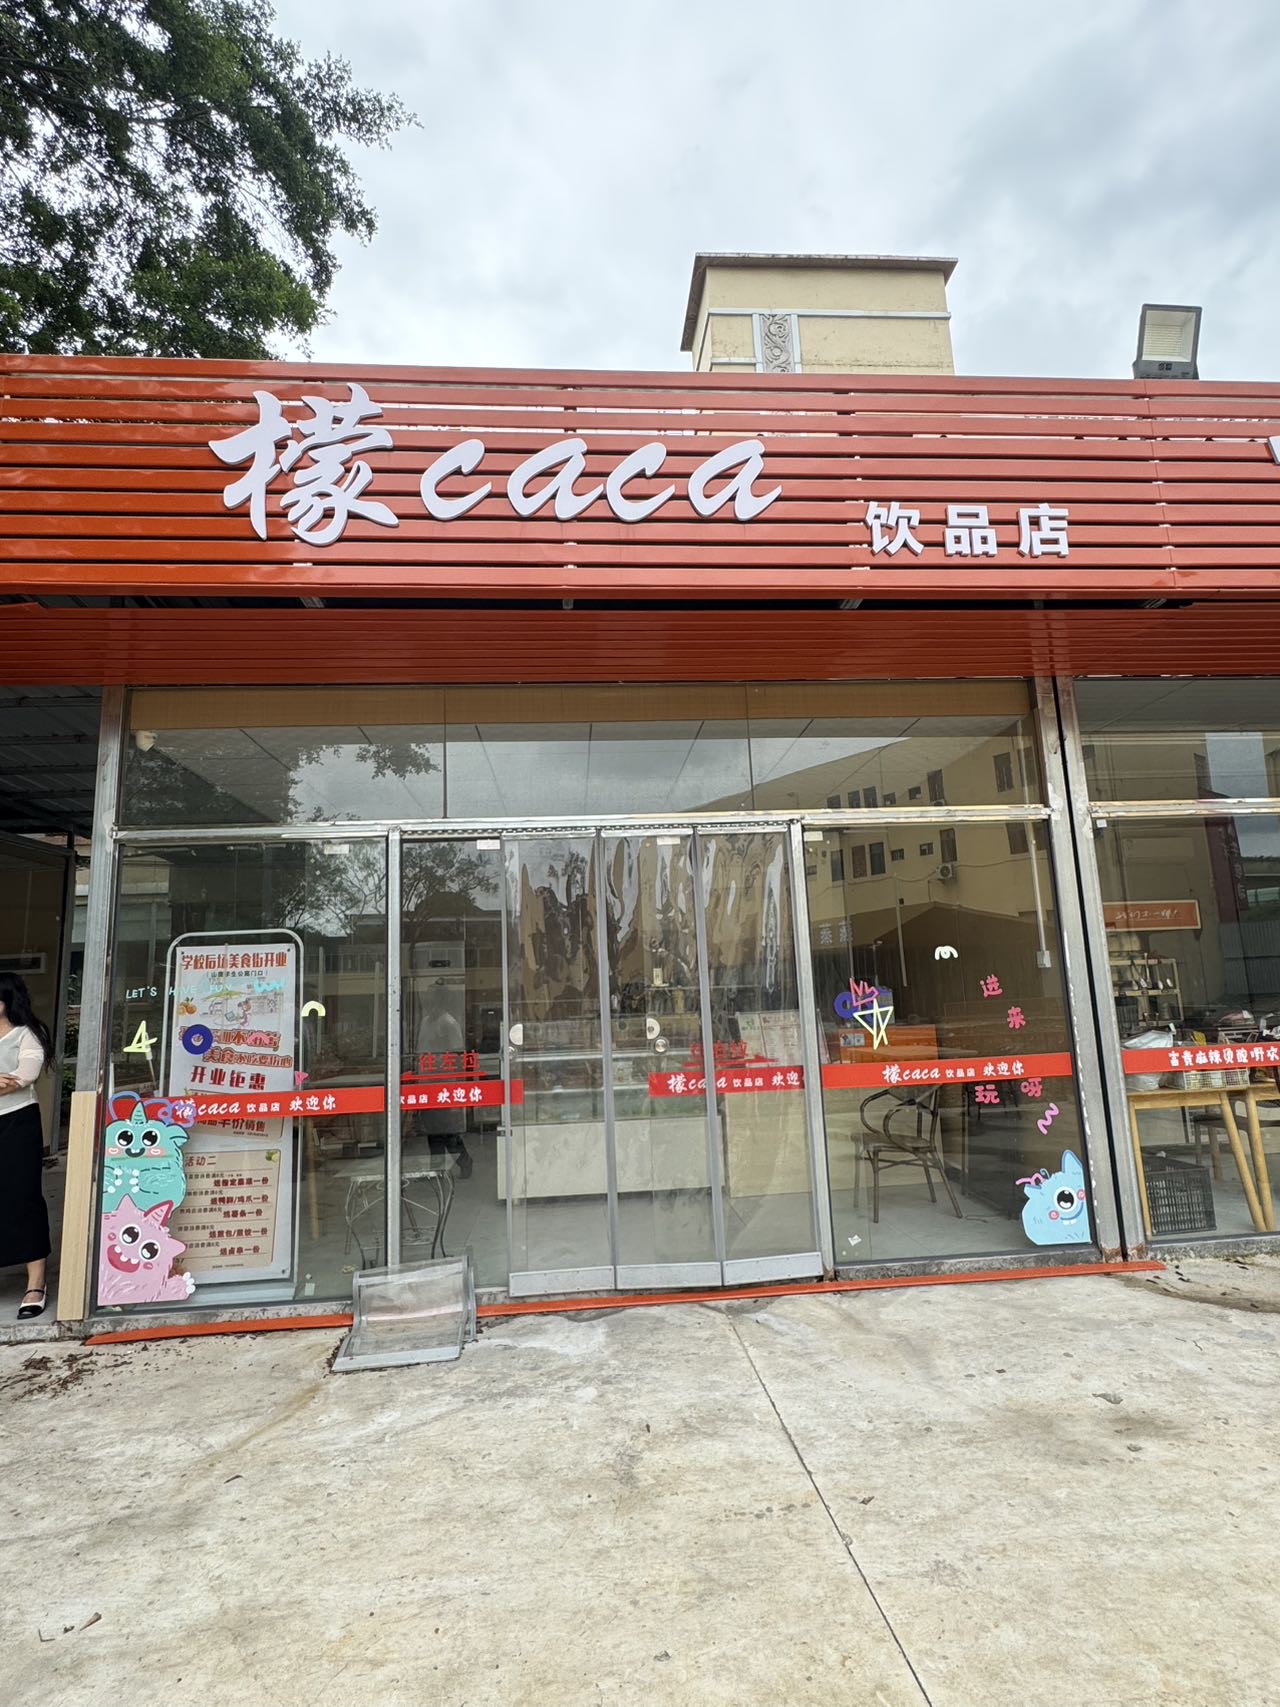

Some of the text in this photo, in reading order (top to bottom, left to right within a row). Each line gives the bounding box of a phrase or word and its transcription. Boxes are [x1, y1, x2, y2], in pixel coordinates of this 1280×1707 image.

[208, 382, 1069, 558] 檬caca 饮品店
[126, 985, 158, 999] LET'S
[980, 974, 1002, 997] 进
[1007, 1006, 1026, 1029] 来
[945, 1067, 976, 1079] 饮品店
[983, 1059, 1025, 1077] 欢迎你
[732, 1077, 764, 1088] 饮品店
[1020, 1077, 1043, 1098] 呀
[246, 1102, 281, 1113] 饮品店
[289, 1094, 337, 1111] 欢迎你
[437, 1086, 483, 1103] 欢迎你
[974, 1084, 1000, 1104] 玩
[185, 1155, 216, 1167] 活动二
